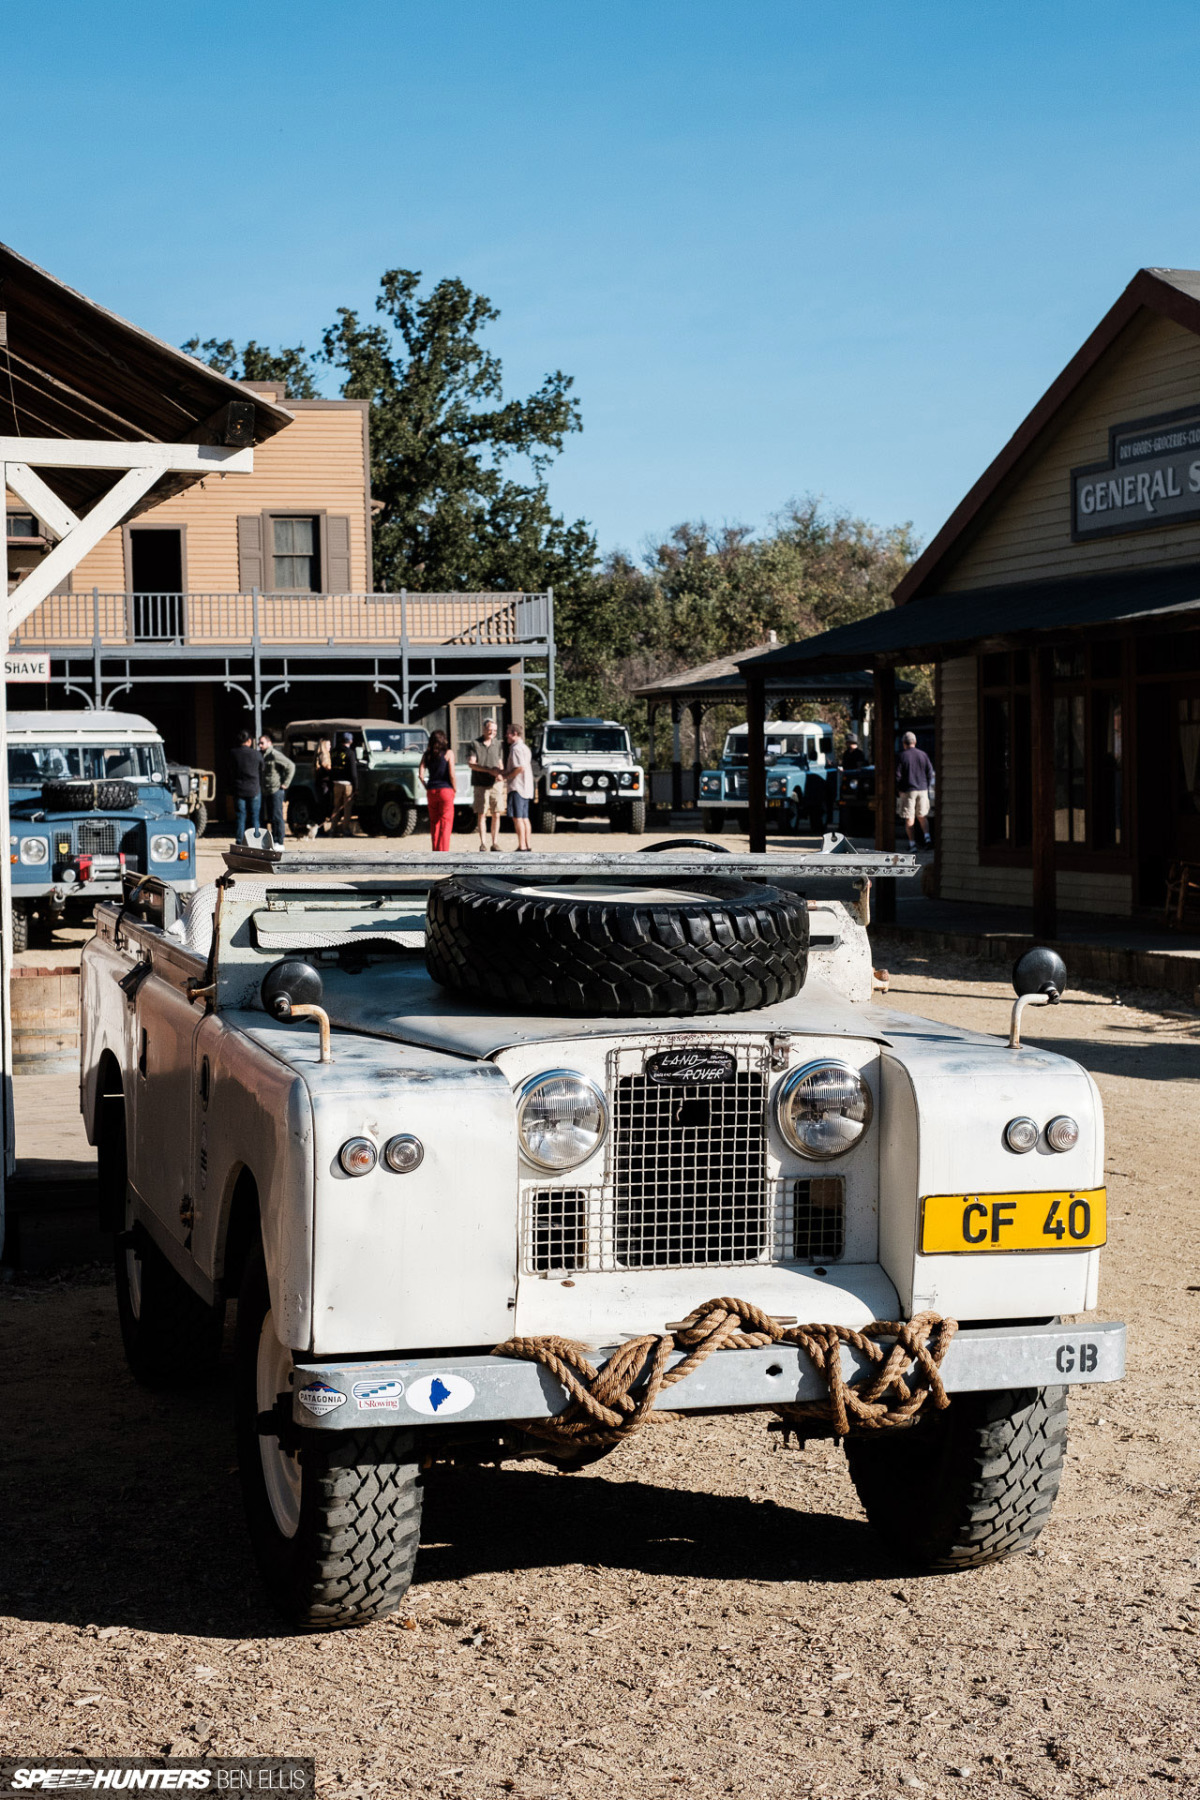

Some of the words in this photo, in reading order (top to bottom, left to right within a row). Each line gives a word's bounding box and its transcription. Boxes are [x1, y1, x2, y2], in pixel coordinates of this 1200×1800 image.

[1080, 467, 1181, 514] GENERAL
[4, 661, 46, 674] SHAVE
[661, 1055, 699, 1066] LAND
[682, 1068, 725, 1080] ROVER
[962, 1202, 1017, 1244] CF
[1043, 1199, 1091, 1240] 40
[1056, 1343, 1098, 1373] GB
[300, 1392, 342, 1403] PATAGONIA
[359, 1400, 398, 1409] USRowing
